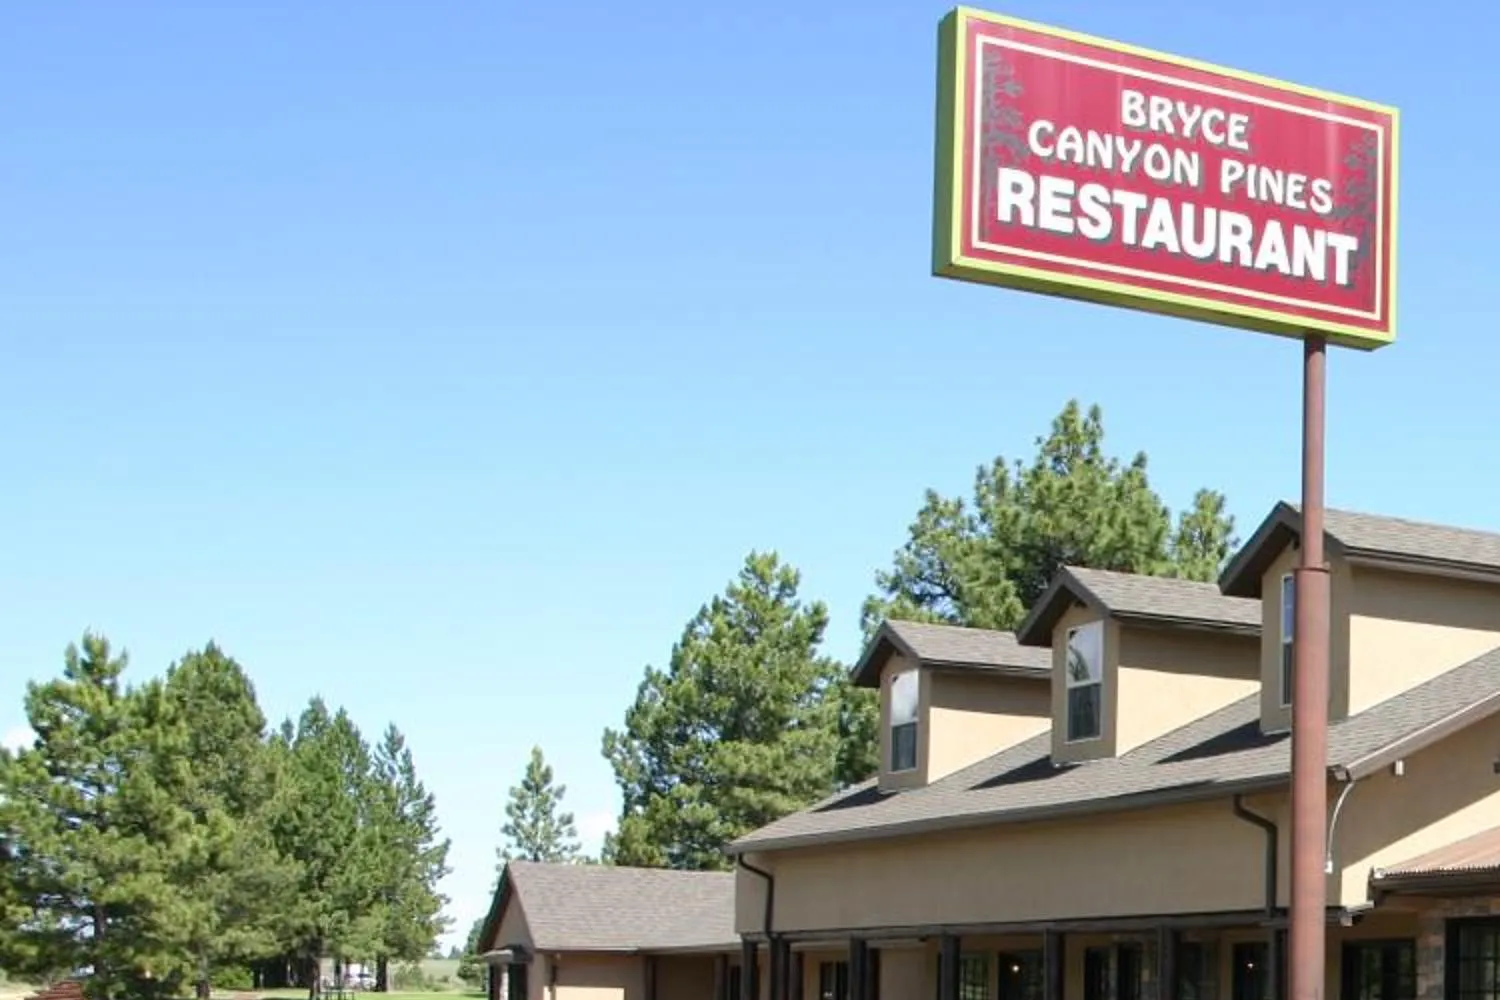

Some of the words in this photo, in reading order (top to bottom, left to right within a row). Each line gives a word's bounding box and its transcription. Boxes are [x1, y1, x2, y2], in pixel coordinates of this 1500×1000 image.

[1027, 119, 1200, 187] CANYON
[1219, 159, 1333, 214] PINES
[1120, 89, 1250, 150] BRYCE
[996, 167, 1358, 287] RESTAURANT
